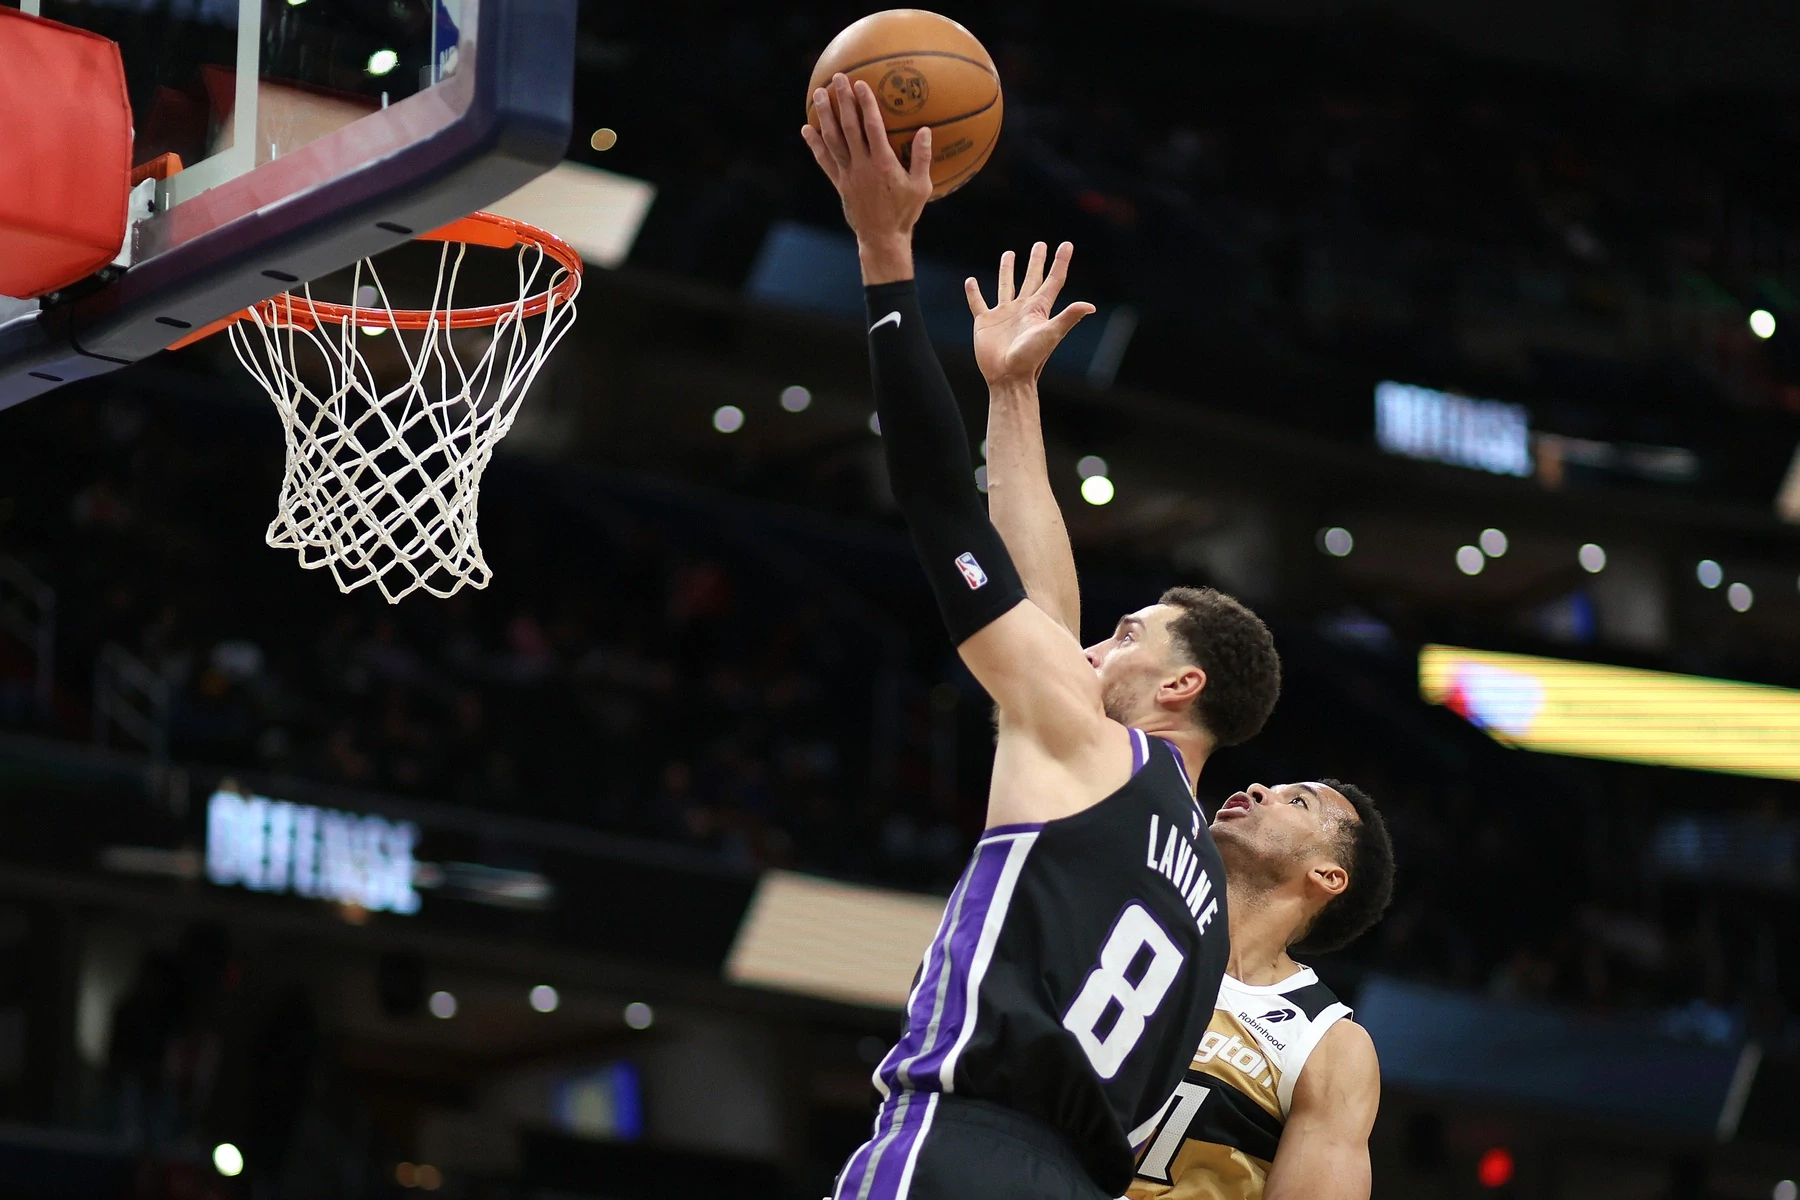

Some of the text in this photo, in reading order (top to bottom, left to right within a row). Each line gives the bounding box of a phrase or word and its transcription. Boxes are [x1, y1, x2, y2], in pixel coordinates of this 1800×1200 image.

[1147, 813, 1218, 936] LAVINE
[1062, 902, 1185, 1080] 8
[1238, 1011, 1286, 1051] Robinhood
